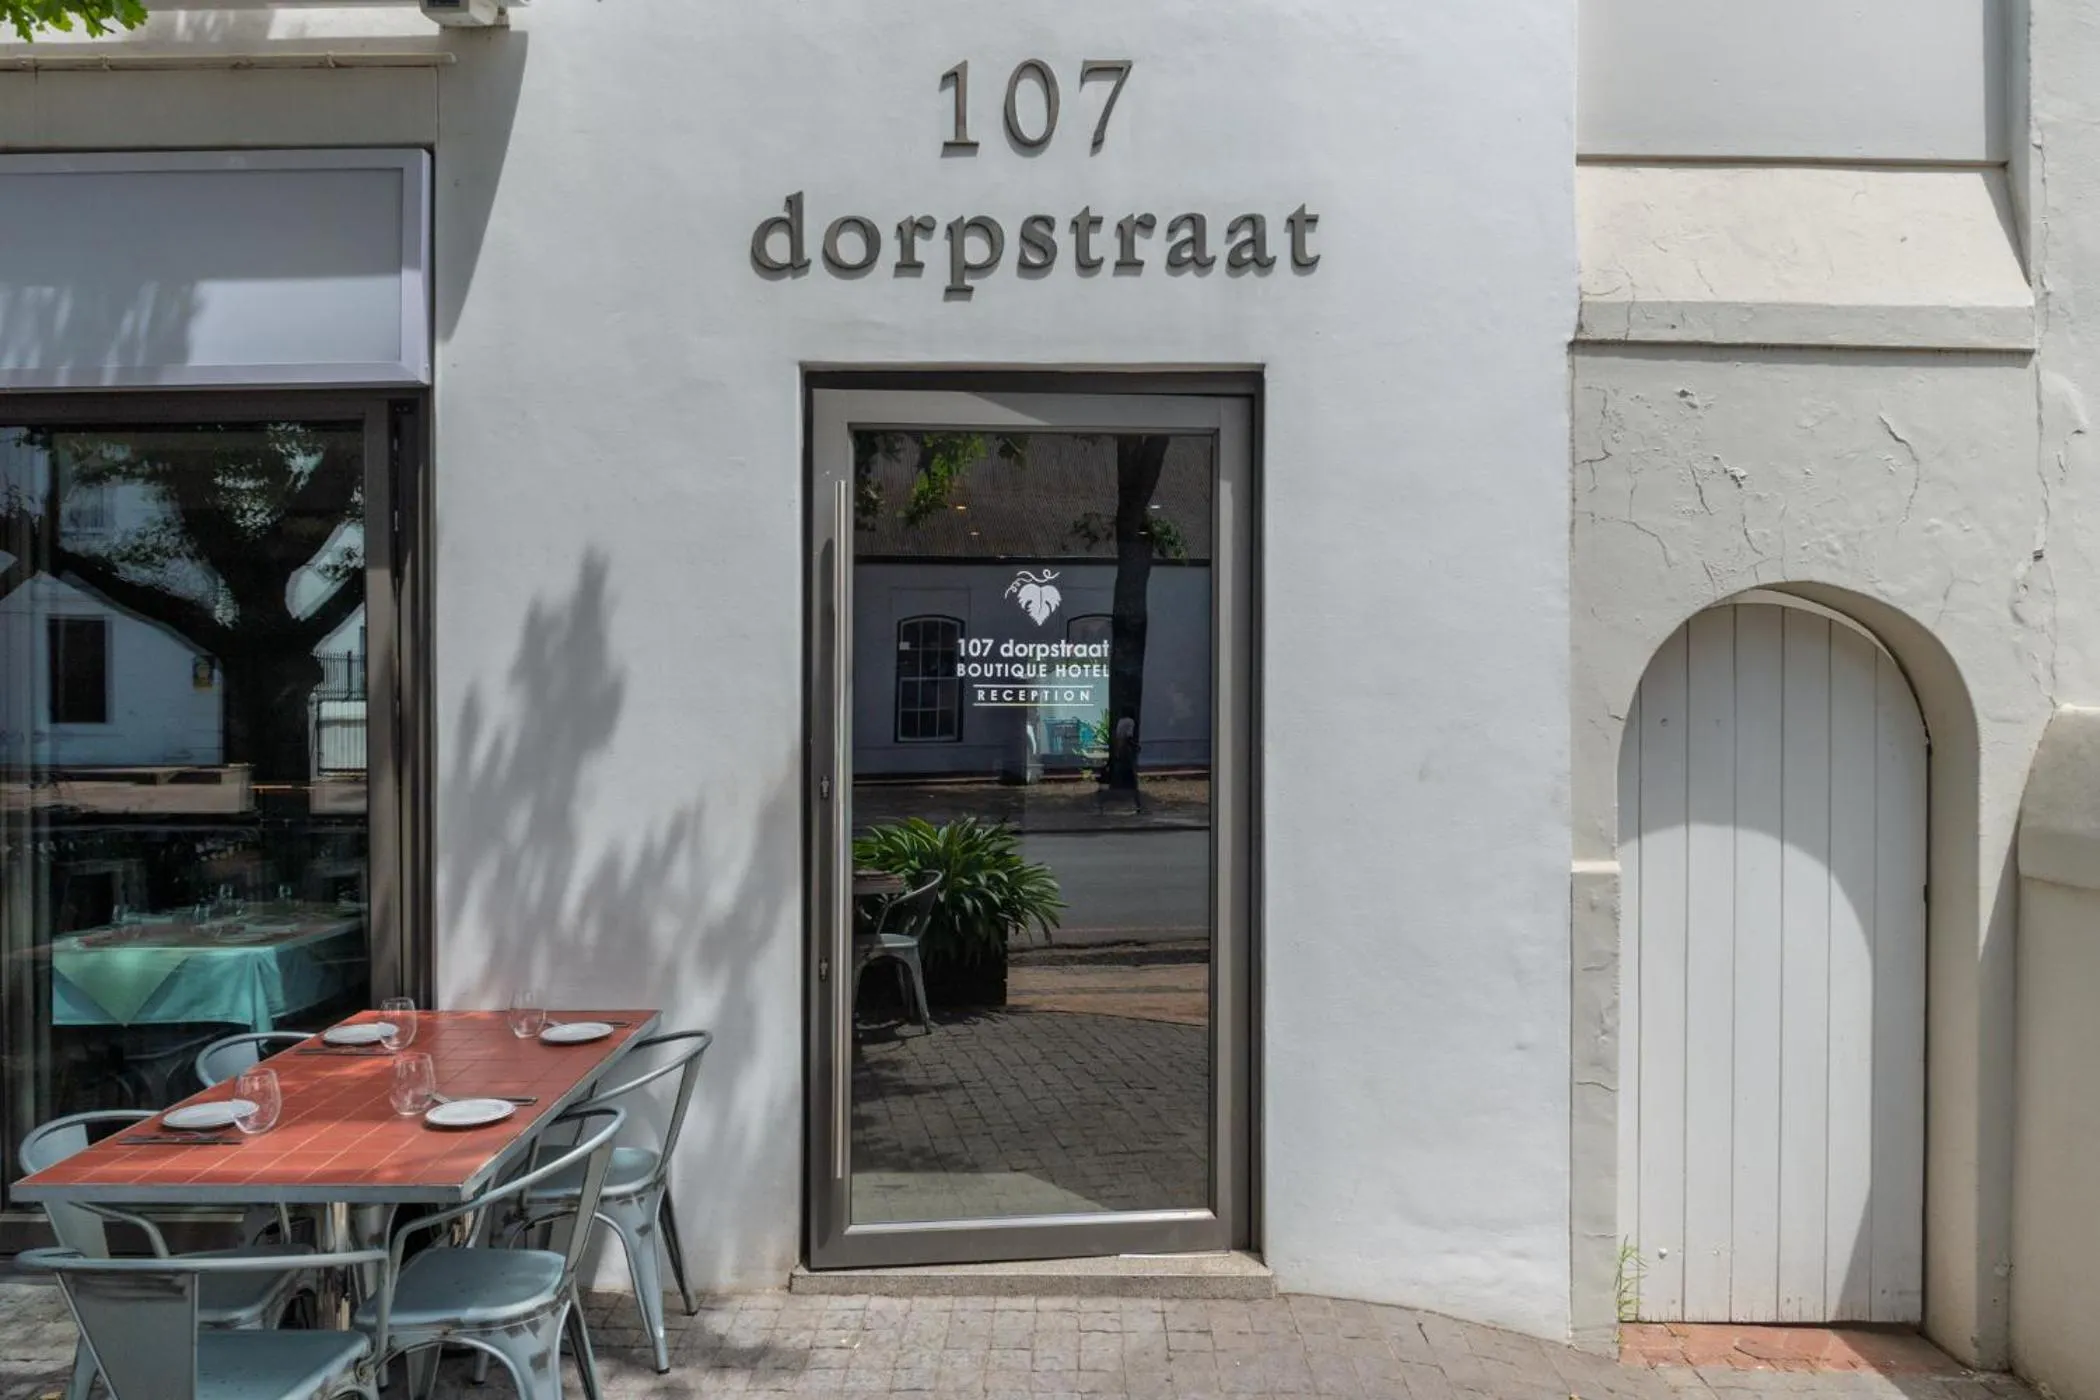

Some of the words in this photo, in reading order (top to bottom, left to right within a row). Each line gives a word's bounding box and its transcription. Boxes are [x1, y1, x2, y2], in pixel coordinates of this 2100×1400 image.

[939, 58, 1133, 156] 107
[750, 190, 1321, 297] dorpstraat
[957, 638, 994, 657] 107
[1000, 639, 1110, 661] dorpstraat
[957, 663, 1047, 679] BOUTIQUE
[1056, 664, 1110, 678] HOTEL
[977, 689, 1090, 701] RECEPTION
